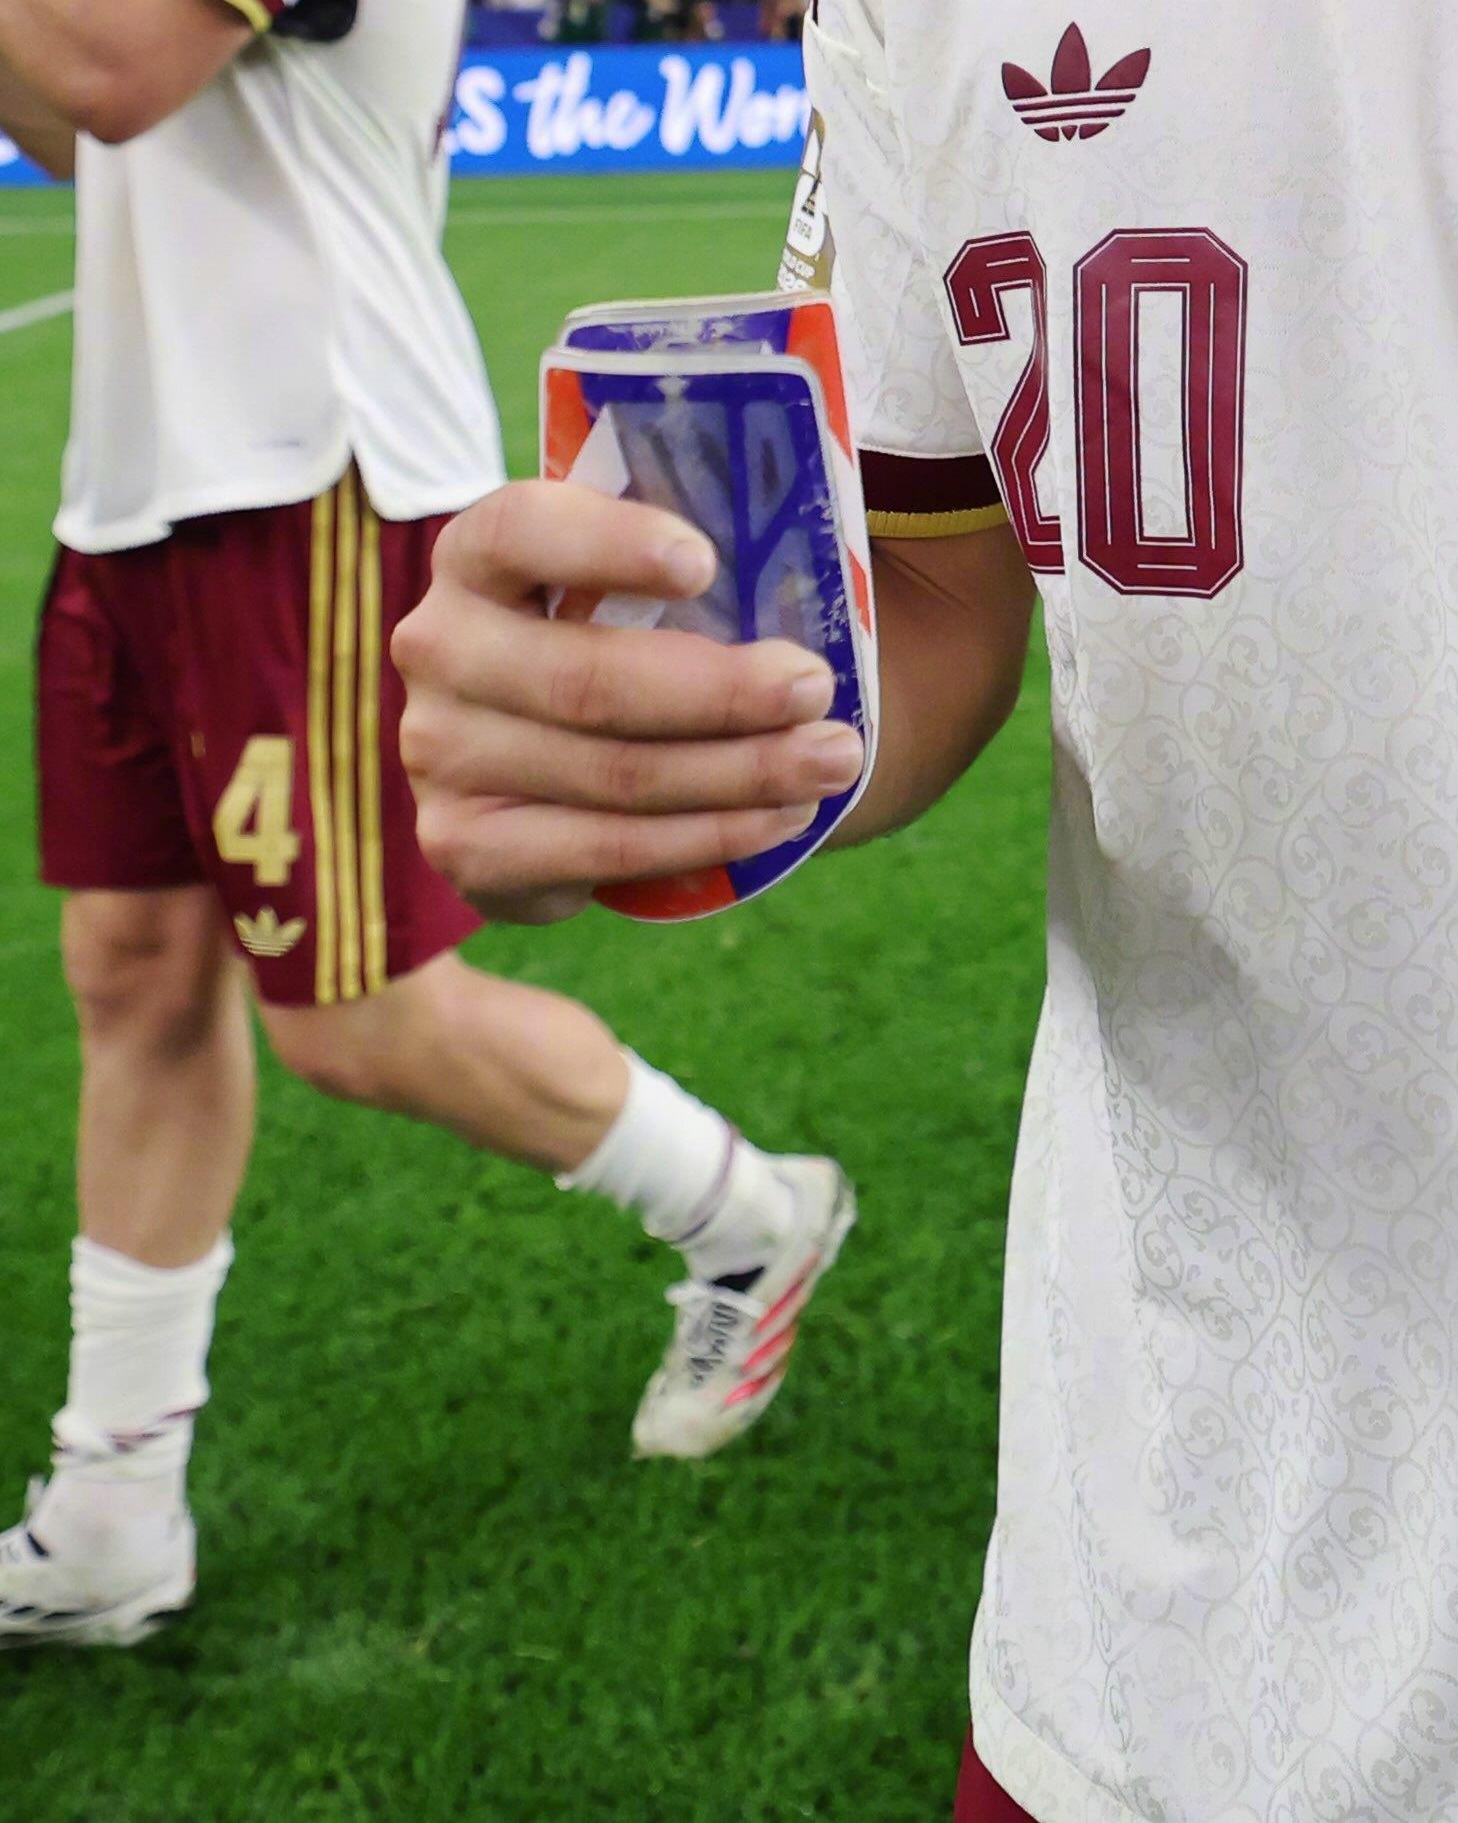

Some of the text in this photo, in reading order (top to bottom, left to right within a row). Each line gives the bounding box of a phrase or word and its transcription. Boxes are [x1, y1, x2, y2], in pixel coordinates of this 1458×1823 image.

[512, 50, 655, 159] the
[943, 226, 1249, 600] 20
[212, 733, 301, 887] 4
